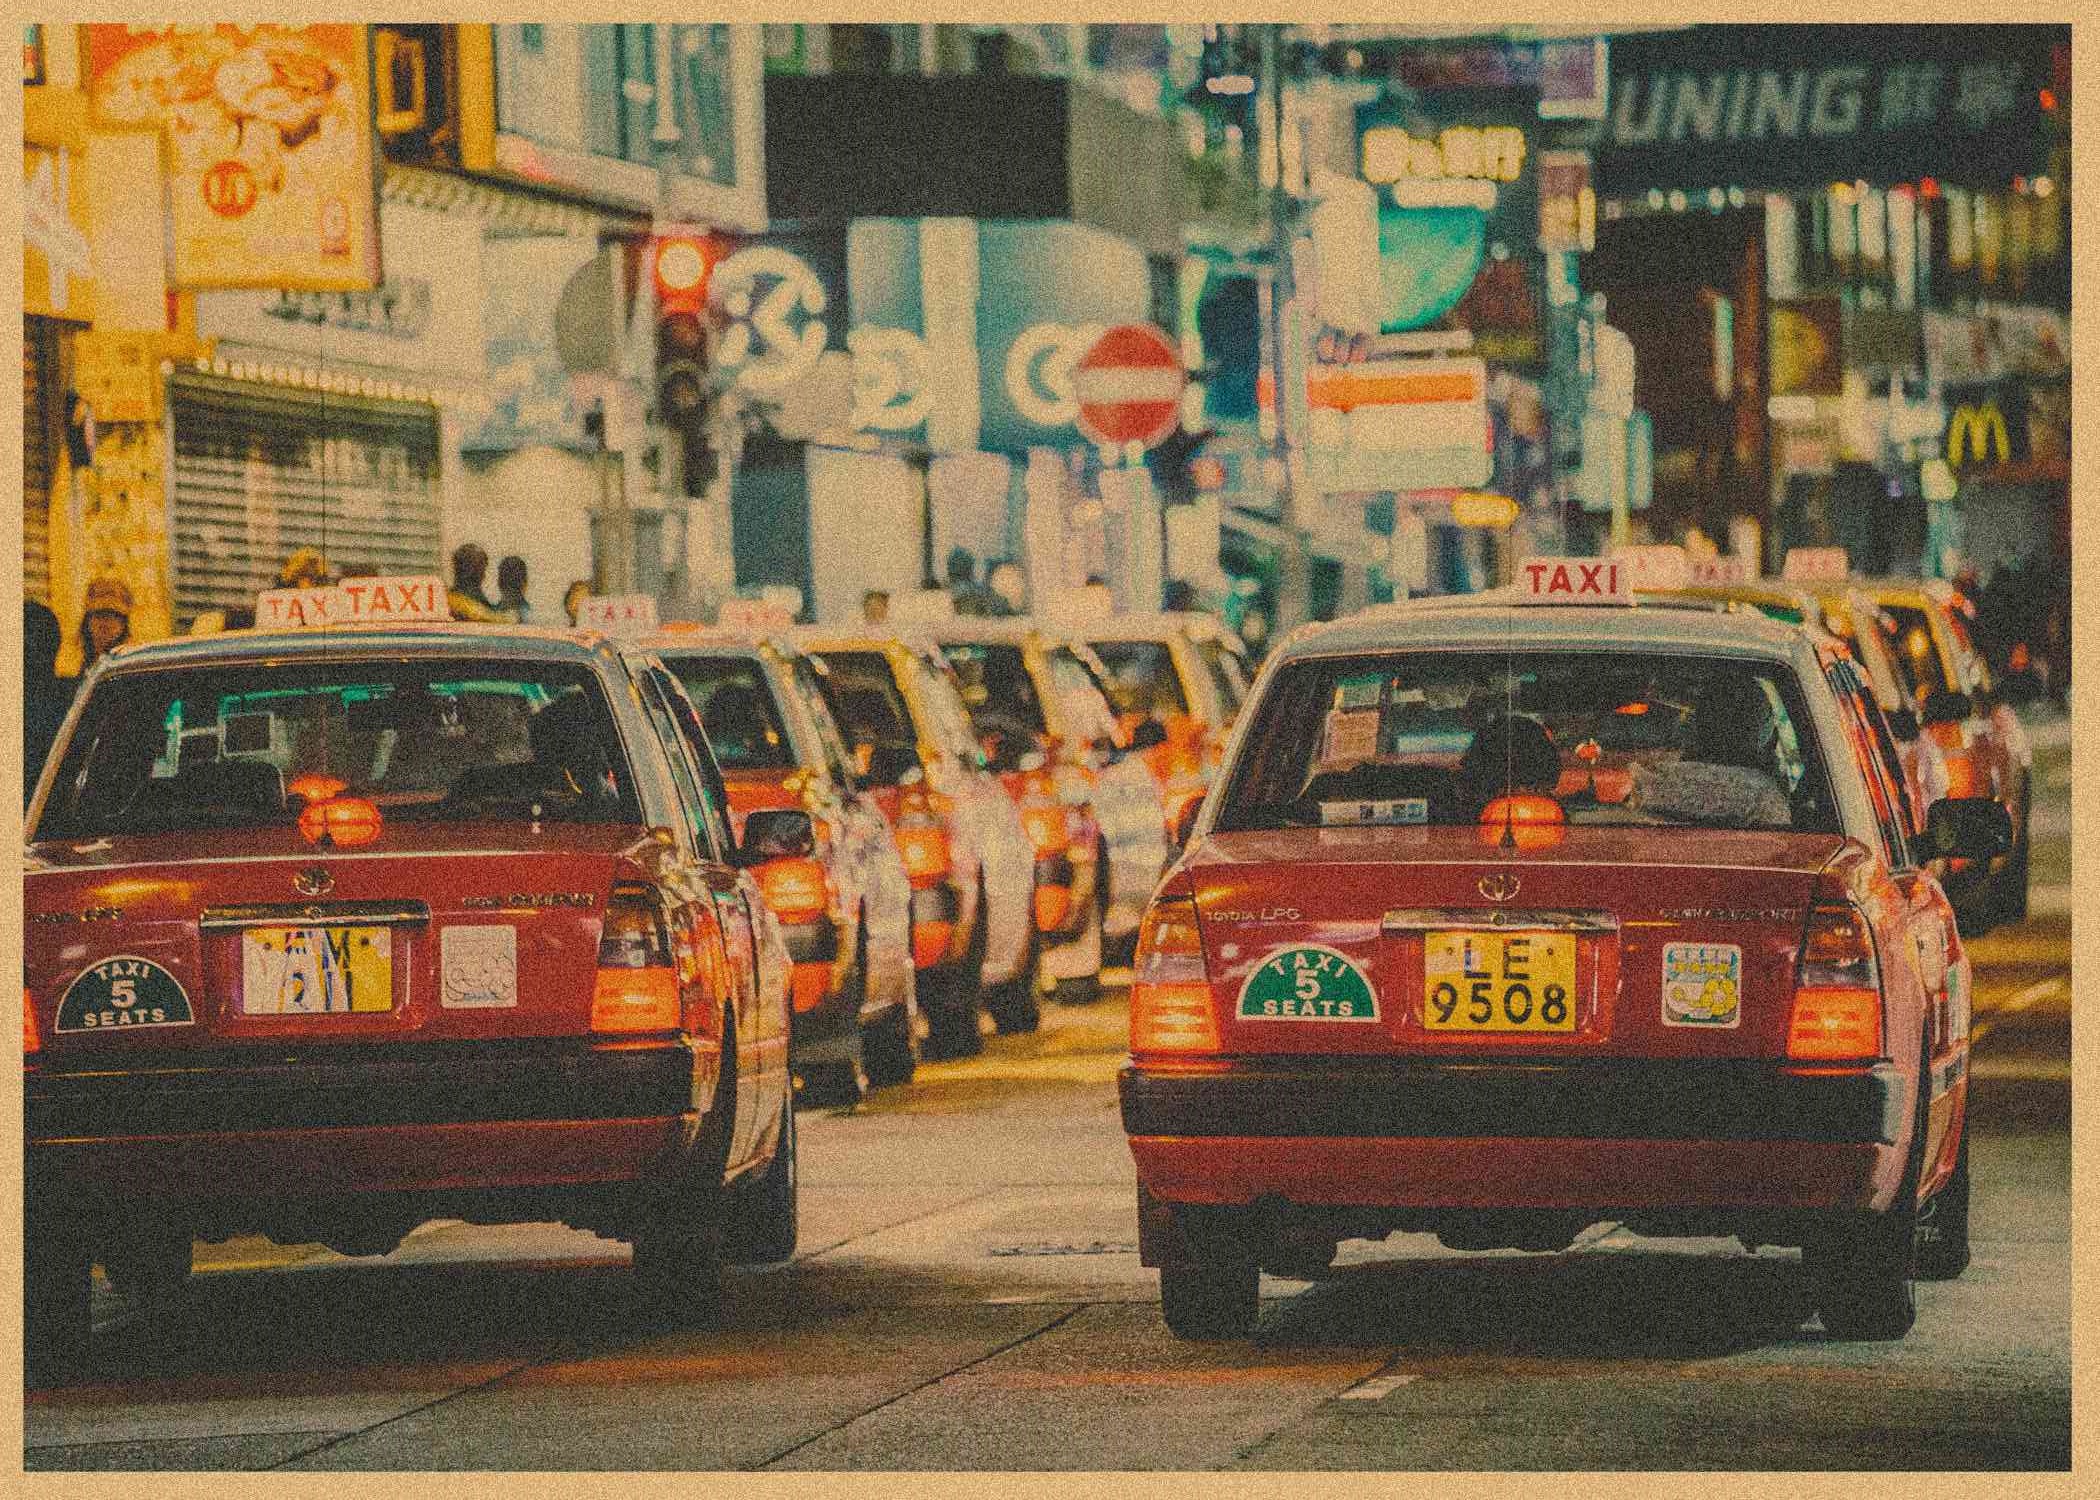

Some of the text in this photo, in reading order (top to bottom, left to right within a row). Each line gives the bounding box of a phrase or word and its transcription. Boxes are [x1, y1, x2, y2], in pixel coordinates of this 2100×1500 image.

[1562, 66, 1870, 146] UNING
[1526, 564, 1617, 595] TAXI
[267, 598, 330, 620] TAX
[345, 584, 436, 614] TAXI
[1260, 907, 1300, 921] LPG
[95, 960, 150, 981] TAXI
[1268, 951, 1348, 979] TAXI
[1464, 939, 1530, 981] LE
[110, 979, 138, 1008] 5
[1295, 968, 1322, 1000] 5
[83, 1007, 167, 1027] SEATS
[1263, 999, 1353, 1016] SEATS
[1431, 982, 1567, 1025] 9508
